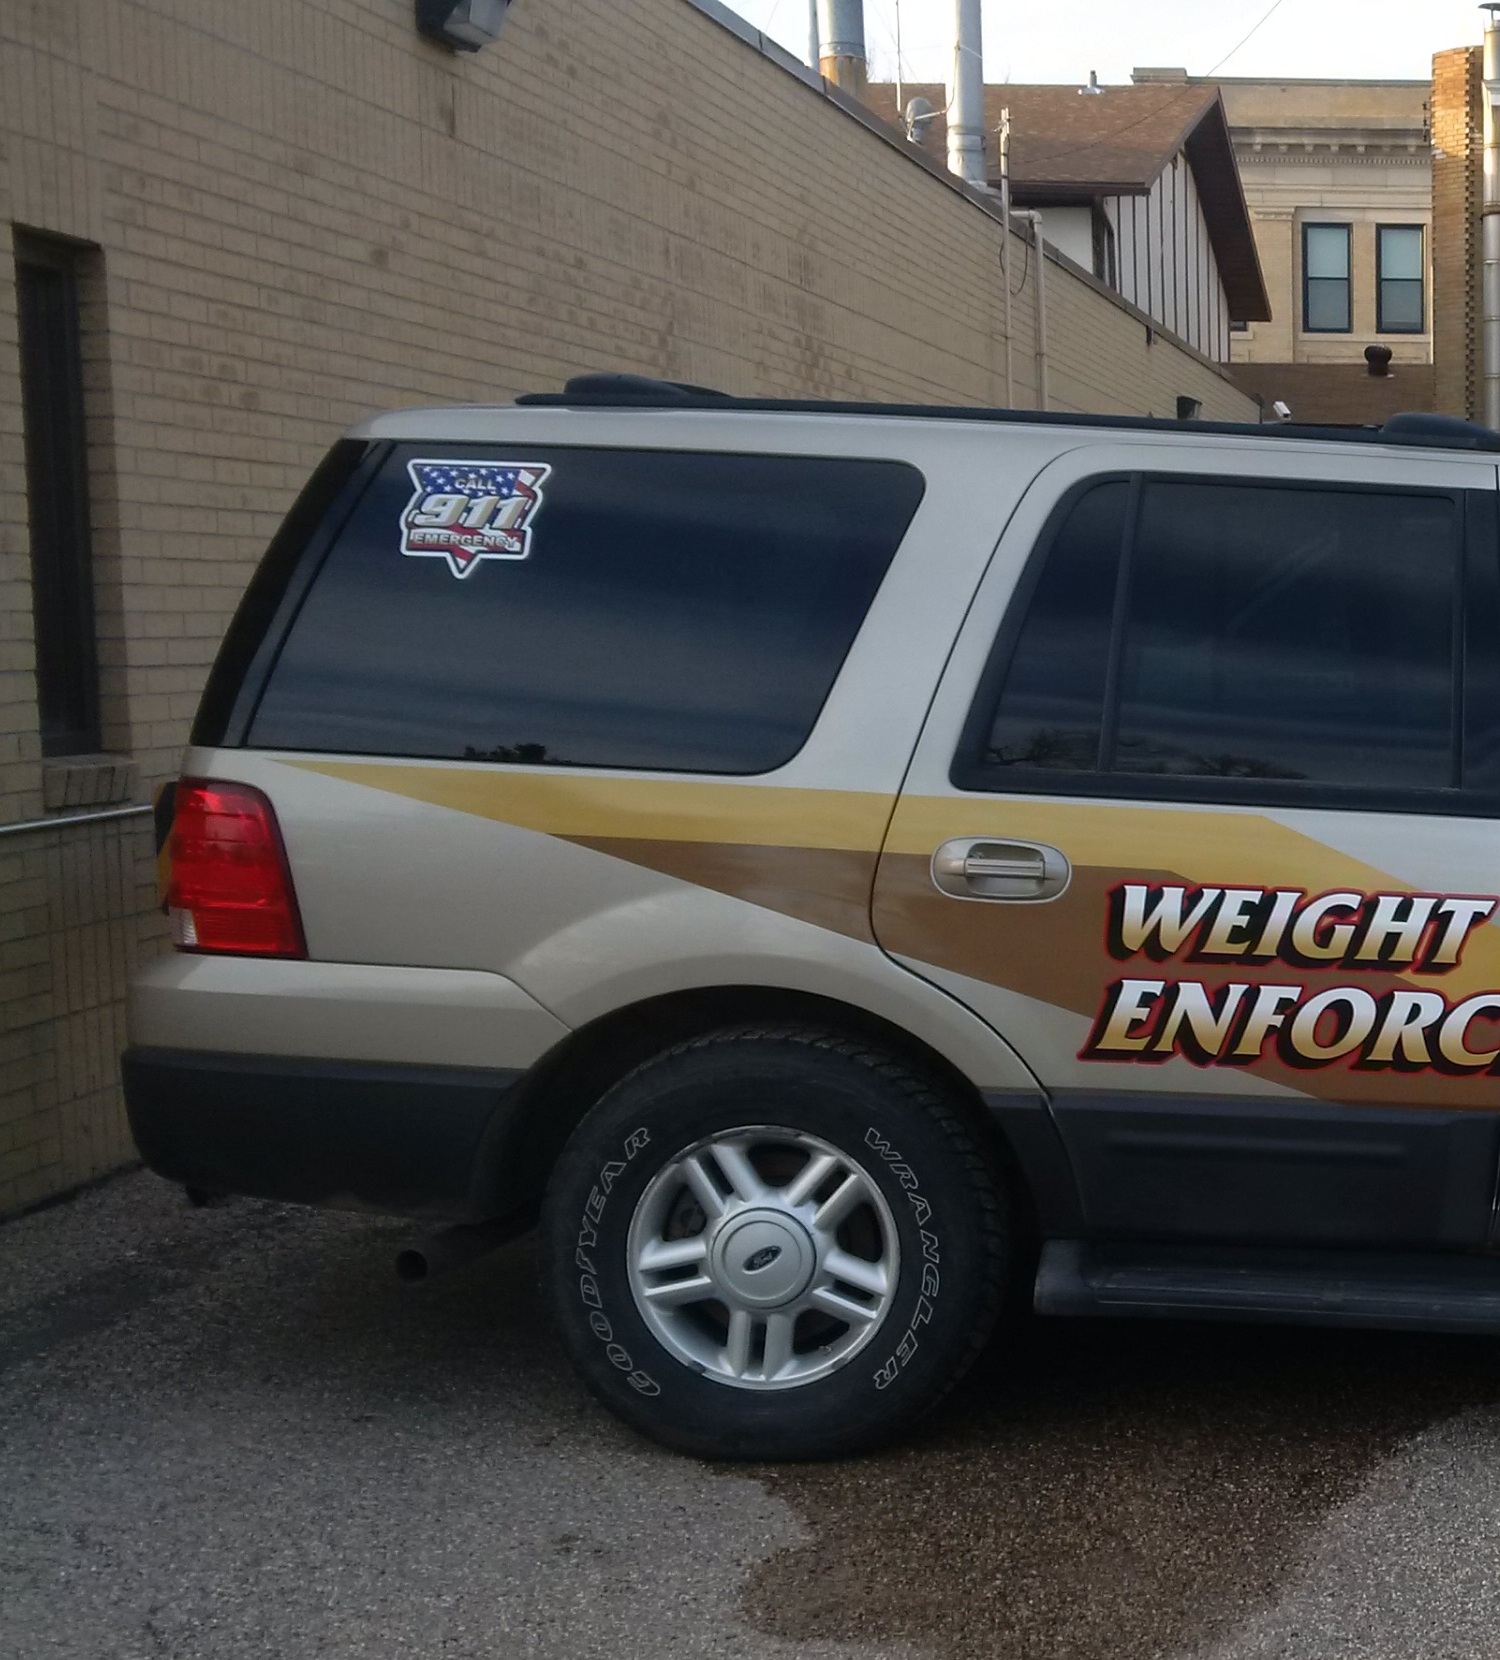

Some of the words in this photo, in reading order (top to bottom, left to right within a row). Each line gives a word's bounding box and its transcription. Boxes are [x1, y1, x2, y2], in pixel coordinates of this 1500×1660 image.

[413, 494, 529, 529] 911
[455, 478, 496, 490] CALL
[414, 533, 518, 548] EMERGENCY
[1103, 884, 1500, 974] WEIGHT
[575, 1127, 661, 1396] GOODYEAR
[863, 1127, 941, 1390] WRANGLER
